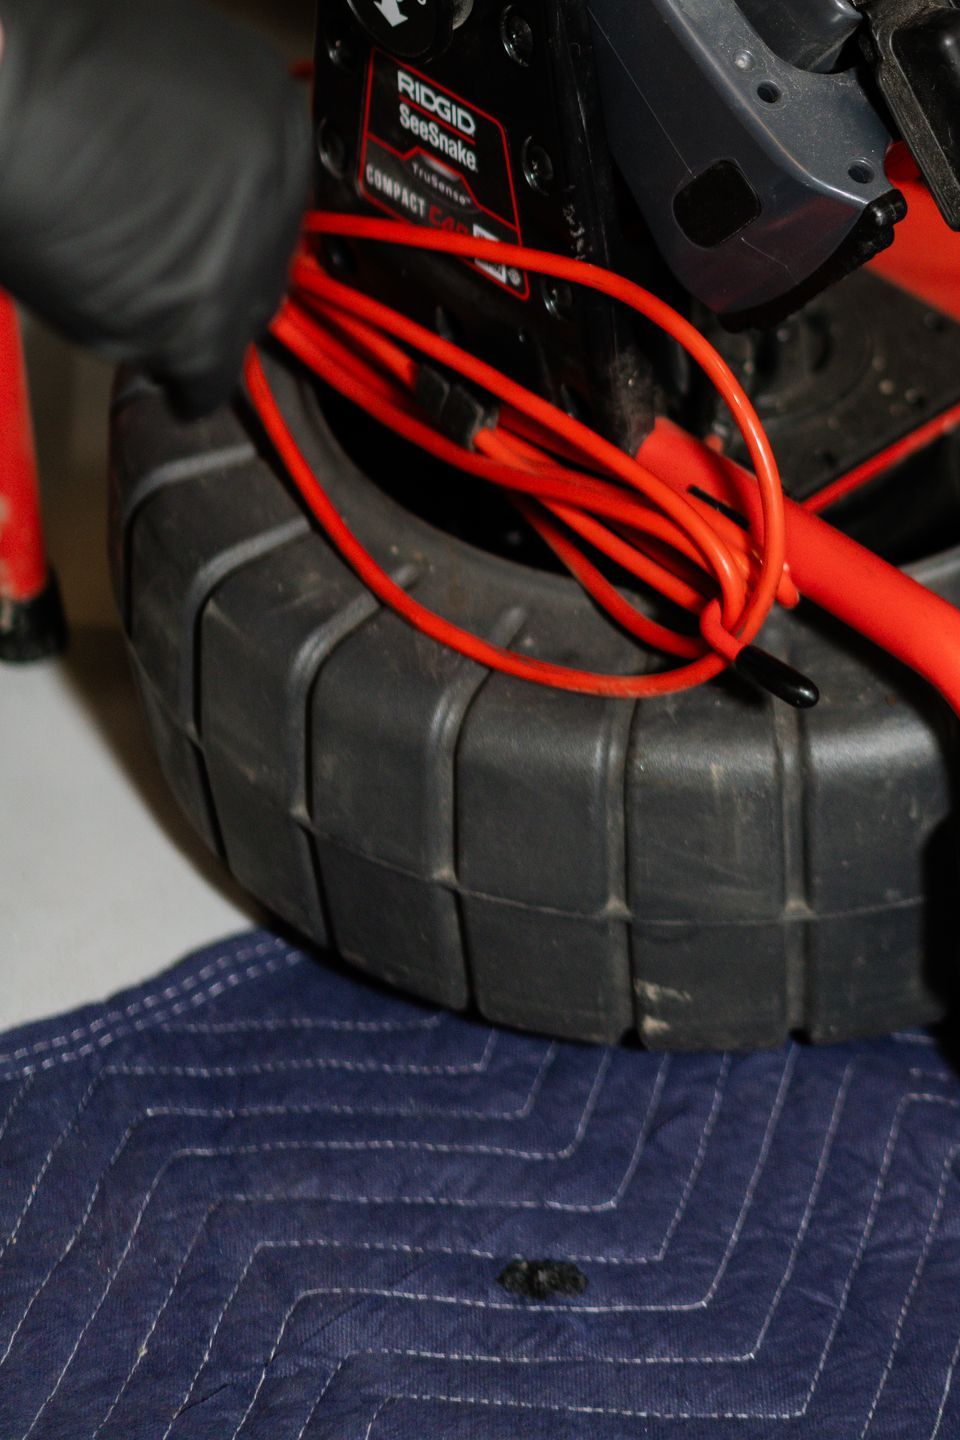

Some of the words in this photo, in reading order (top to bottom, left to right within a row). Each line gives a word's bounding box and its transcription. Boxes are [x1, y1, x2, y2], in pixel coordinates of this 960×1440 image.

[398, 71, 476, 136] RIDGID
[399, 104, 478, 172] SeeSnake
[366, 163, 426, 216] COMPACT
